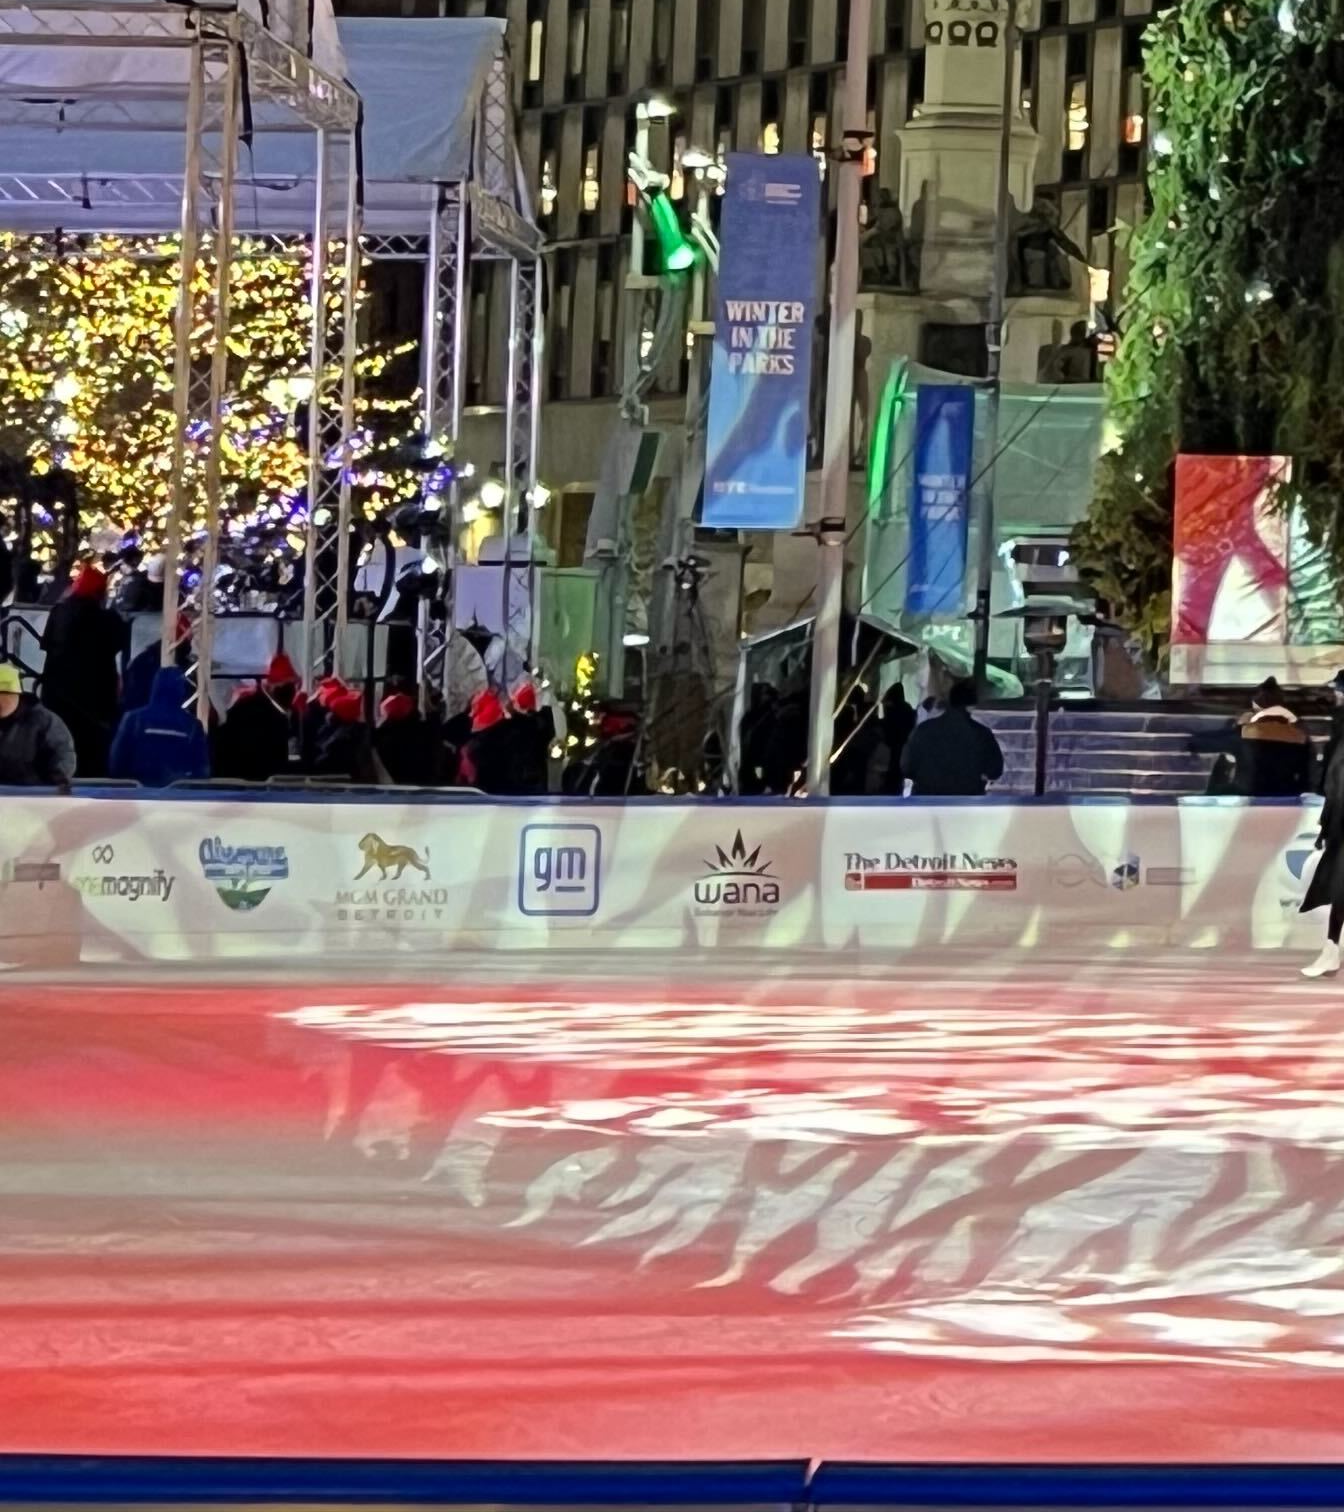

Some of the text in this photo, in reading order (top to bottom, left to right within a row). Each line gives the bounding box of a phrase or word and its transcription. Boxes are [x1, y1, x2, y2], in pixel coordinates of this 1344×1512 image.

[725, 300, 804, 324] WINTER
[731, 325, 796, 349] IN THE
[728, 352, 794, 375] PARKS
[534, 847, 586, 892] gm
[885, 852, 957, 871] Detroit
[335, 888, 449, 906] MGM GRAND
[694, 882, 780, 905] wana
[337, 908, 444, 922] DETROIT
